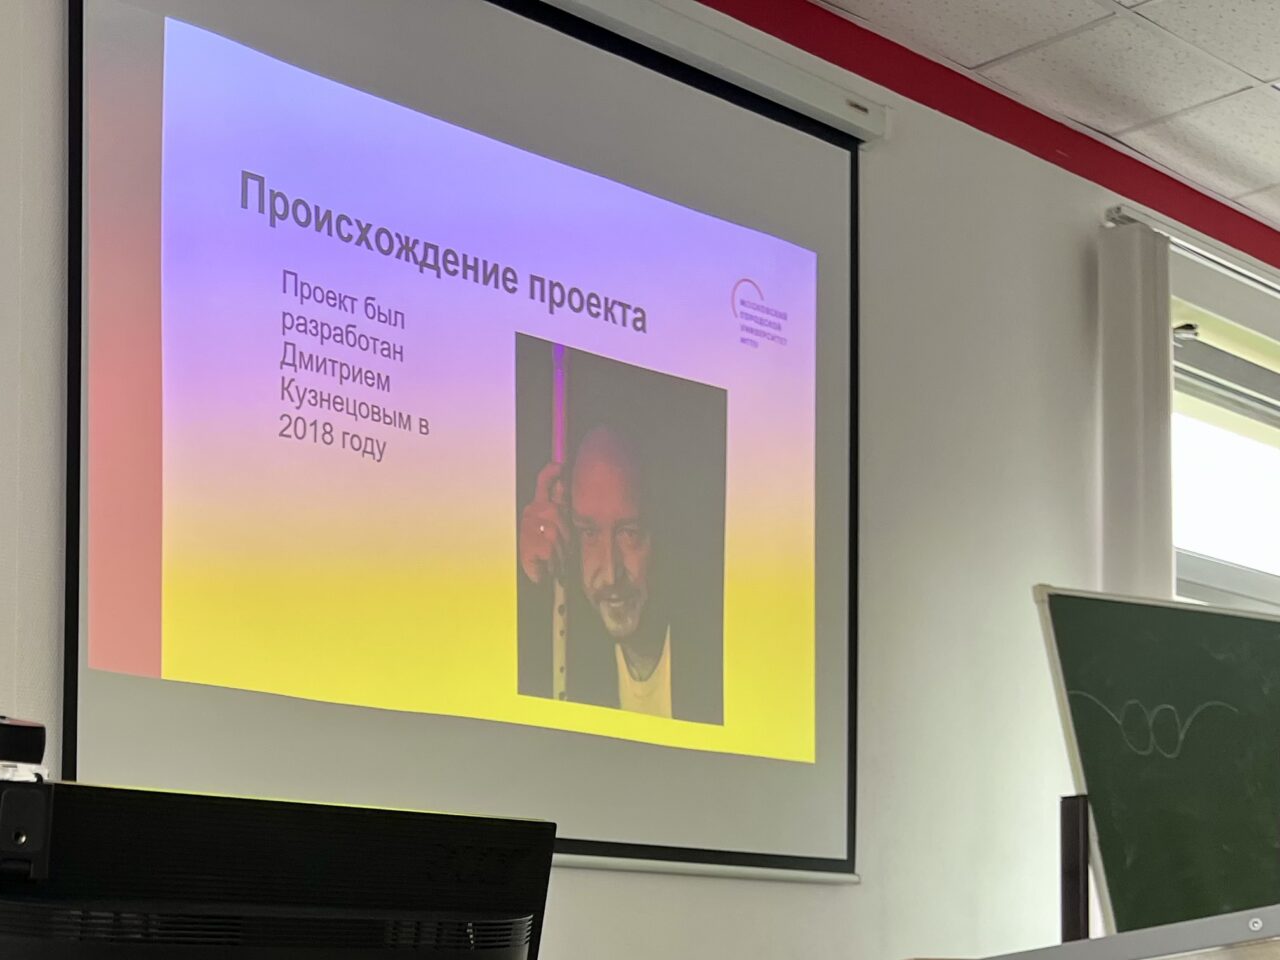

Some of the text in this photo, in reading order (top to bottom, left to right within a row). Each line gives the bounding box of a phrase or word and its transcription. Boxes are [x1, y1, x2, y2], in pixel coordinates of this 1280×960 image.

[240, 170, 648, 334] Происхождение проекта
[282, 269, 406, 330] Проект был
[282, 311, 404, 363] разработан
[280, 340, 391, 393] Дмитрием
[280, 375, 431, 436] Кузнецовым в
[278, 413, 388, 463] 2018 году
